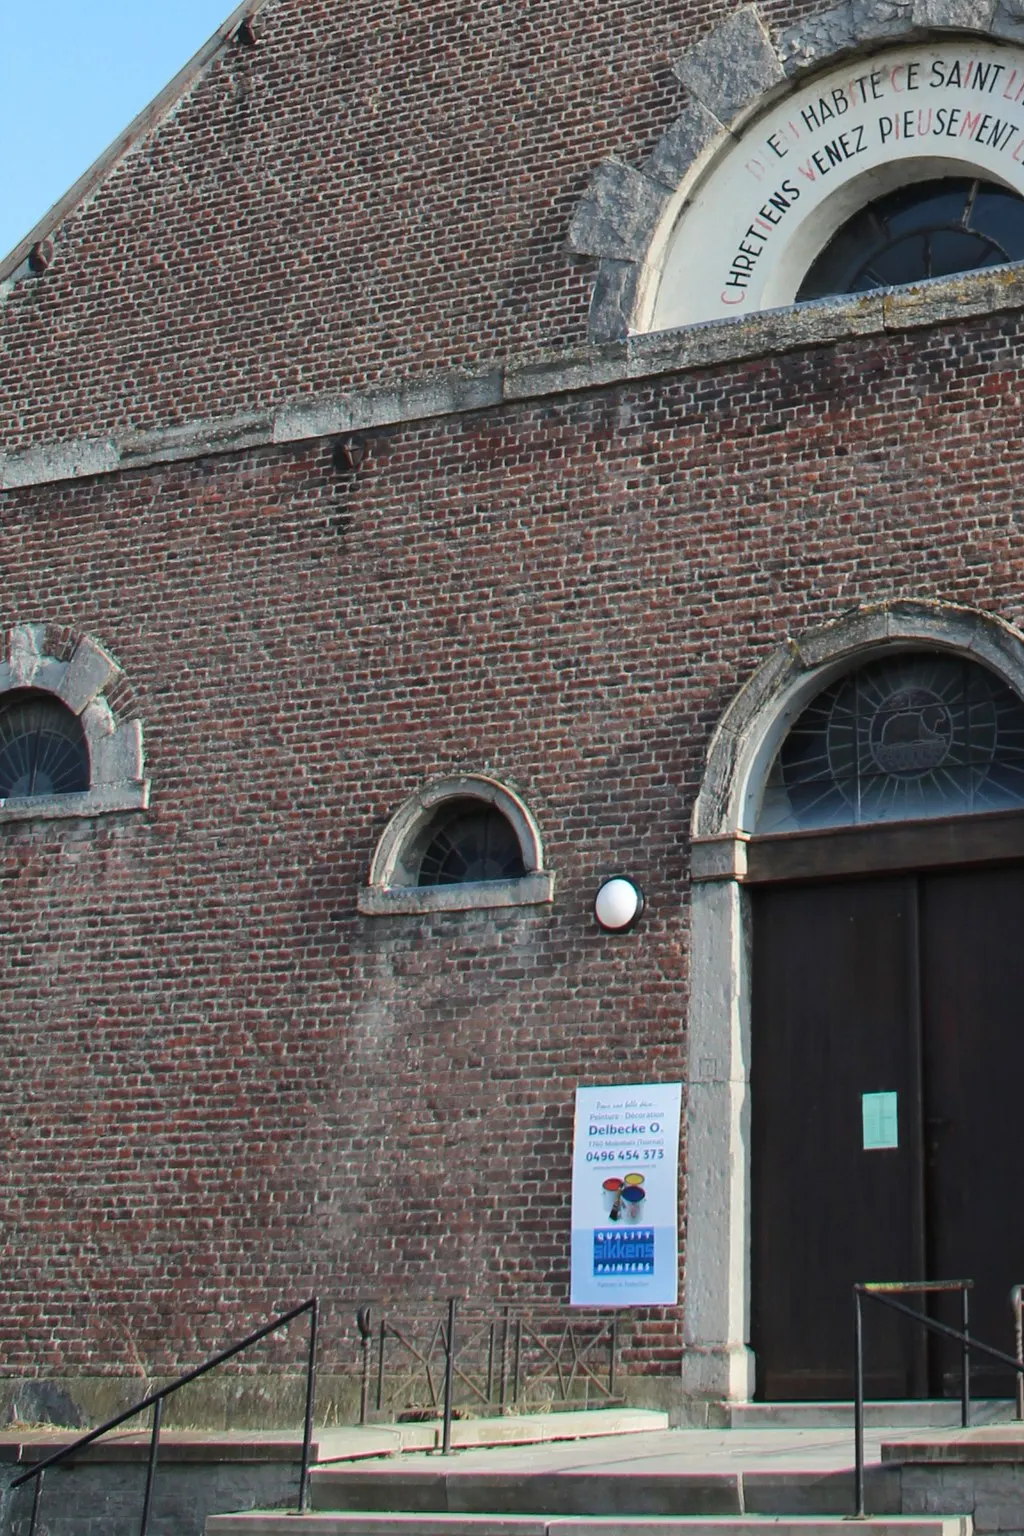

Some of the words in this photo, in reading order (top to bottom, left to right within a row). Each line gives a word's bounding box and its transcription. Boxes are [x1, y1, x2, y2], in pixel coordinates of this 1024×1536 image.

[800, 71, 884, 132] HABITE
[890, 62, 921, 94] CE
[929, 60, 1005, 94] SAINT
[720, 179, 801, 305] CHRETIENS
[798, 124, 868, 183] VENEZ
[878, 108, 1020, 152] PIEUSEMENT
[589, 1124, 646, 1135] Delbecke
[586, 1150, 615, 1162] 0496
[617, 1149, 640, 1161] 454
[643, 1148, 665, 1160] 373
[597, 1231, 650, 1241] QUALITY
[594, 1240, 654, 1259] sikkens
[597, 1262, 650, 1273] PAINTERS
